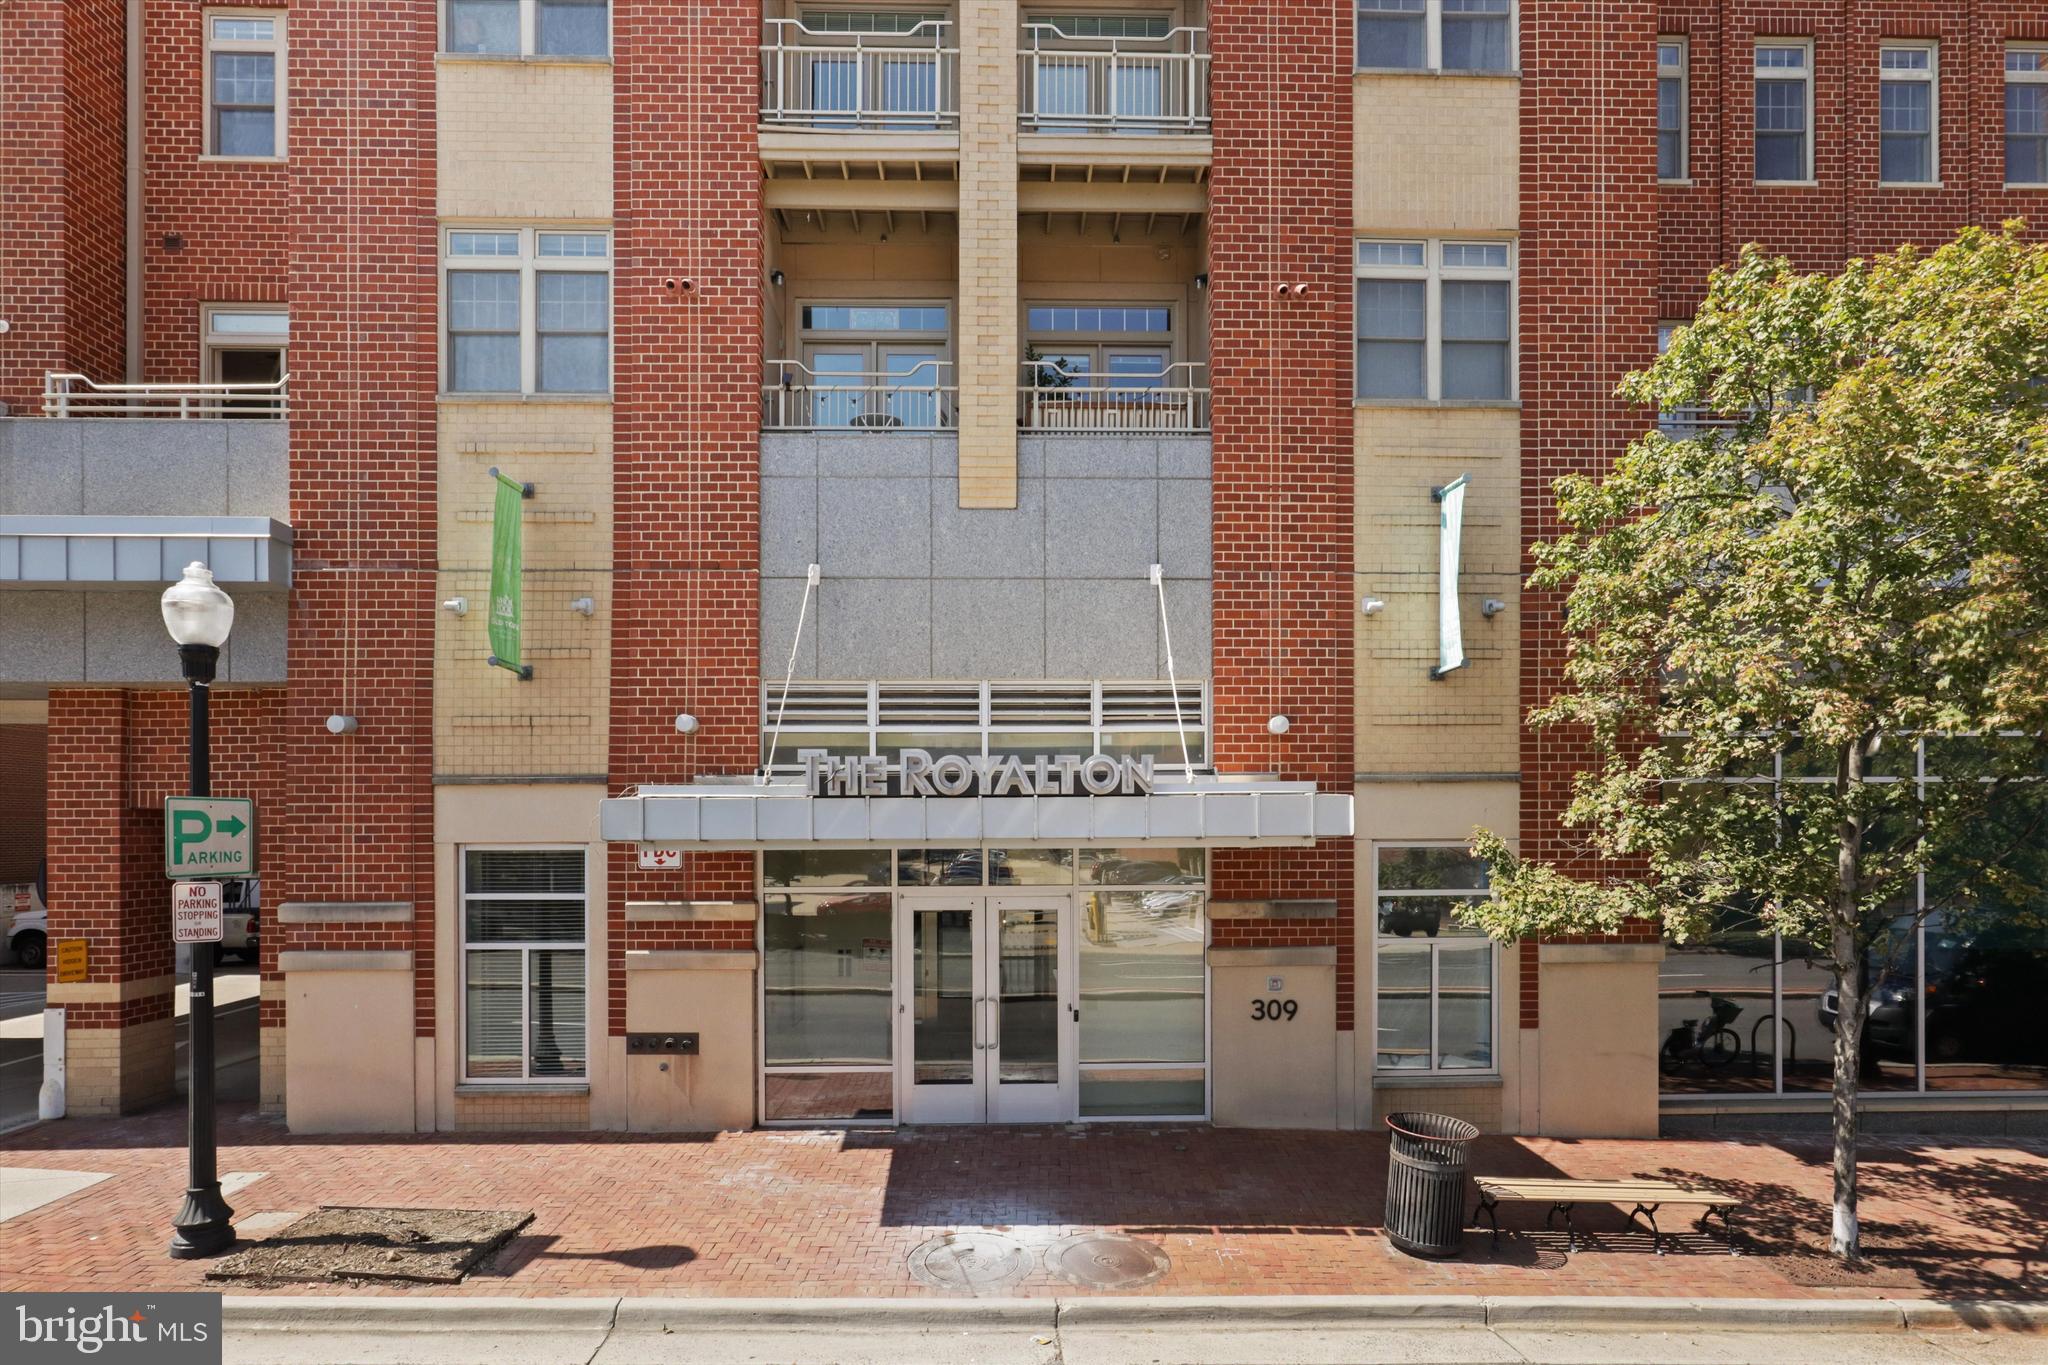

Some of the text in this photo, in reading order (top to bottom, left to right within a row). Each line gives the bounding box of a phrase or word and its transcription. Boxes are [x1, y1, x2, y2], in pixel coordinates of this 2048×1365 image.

[797, 748, 1155, 796] THE ROYALTON
[189, 886, 206, 897] NO
[178, 899, 217, 909] PARKING
[177, 911, 218, 920] STOPPING
[178, 927, 218, 938] STANDING
[1250, 999, 1298, 1022] 309
